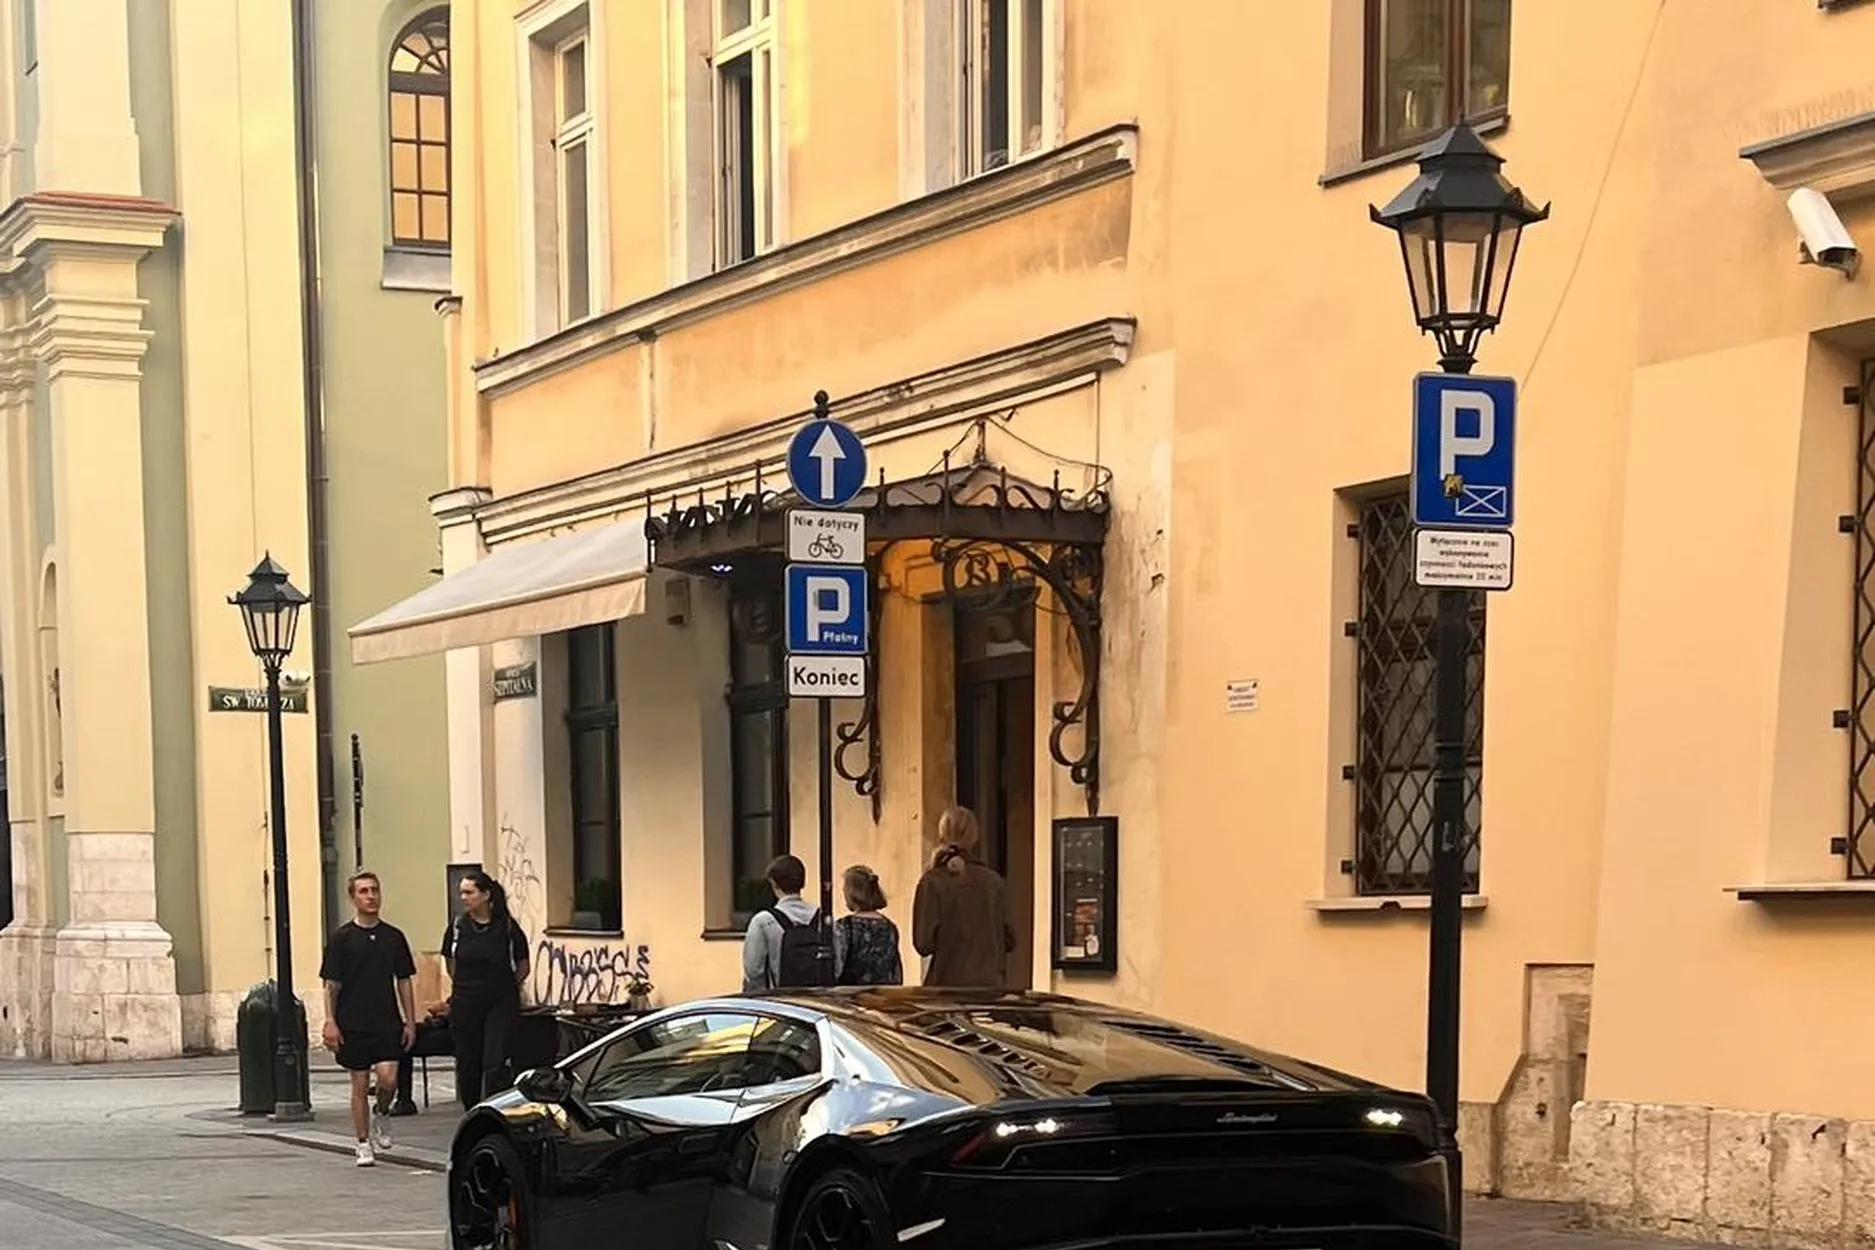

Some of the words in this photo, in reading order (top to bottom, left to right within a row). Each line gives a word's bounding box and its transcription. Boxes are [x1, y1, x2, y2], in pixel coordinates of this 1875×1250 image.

[1440, 388, 1495, 482] P
[794, 515, 813, 527] Nie
[817, 517, 859, 532] dotyczy
[806, 575, 850, 642] P
[793, 666, 860, 687] Koniec
